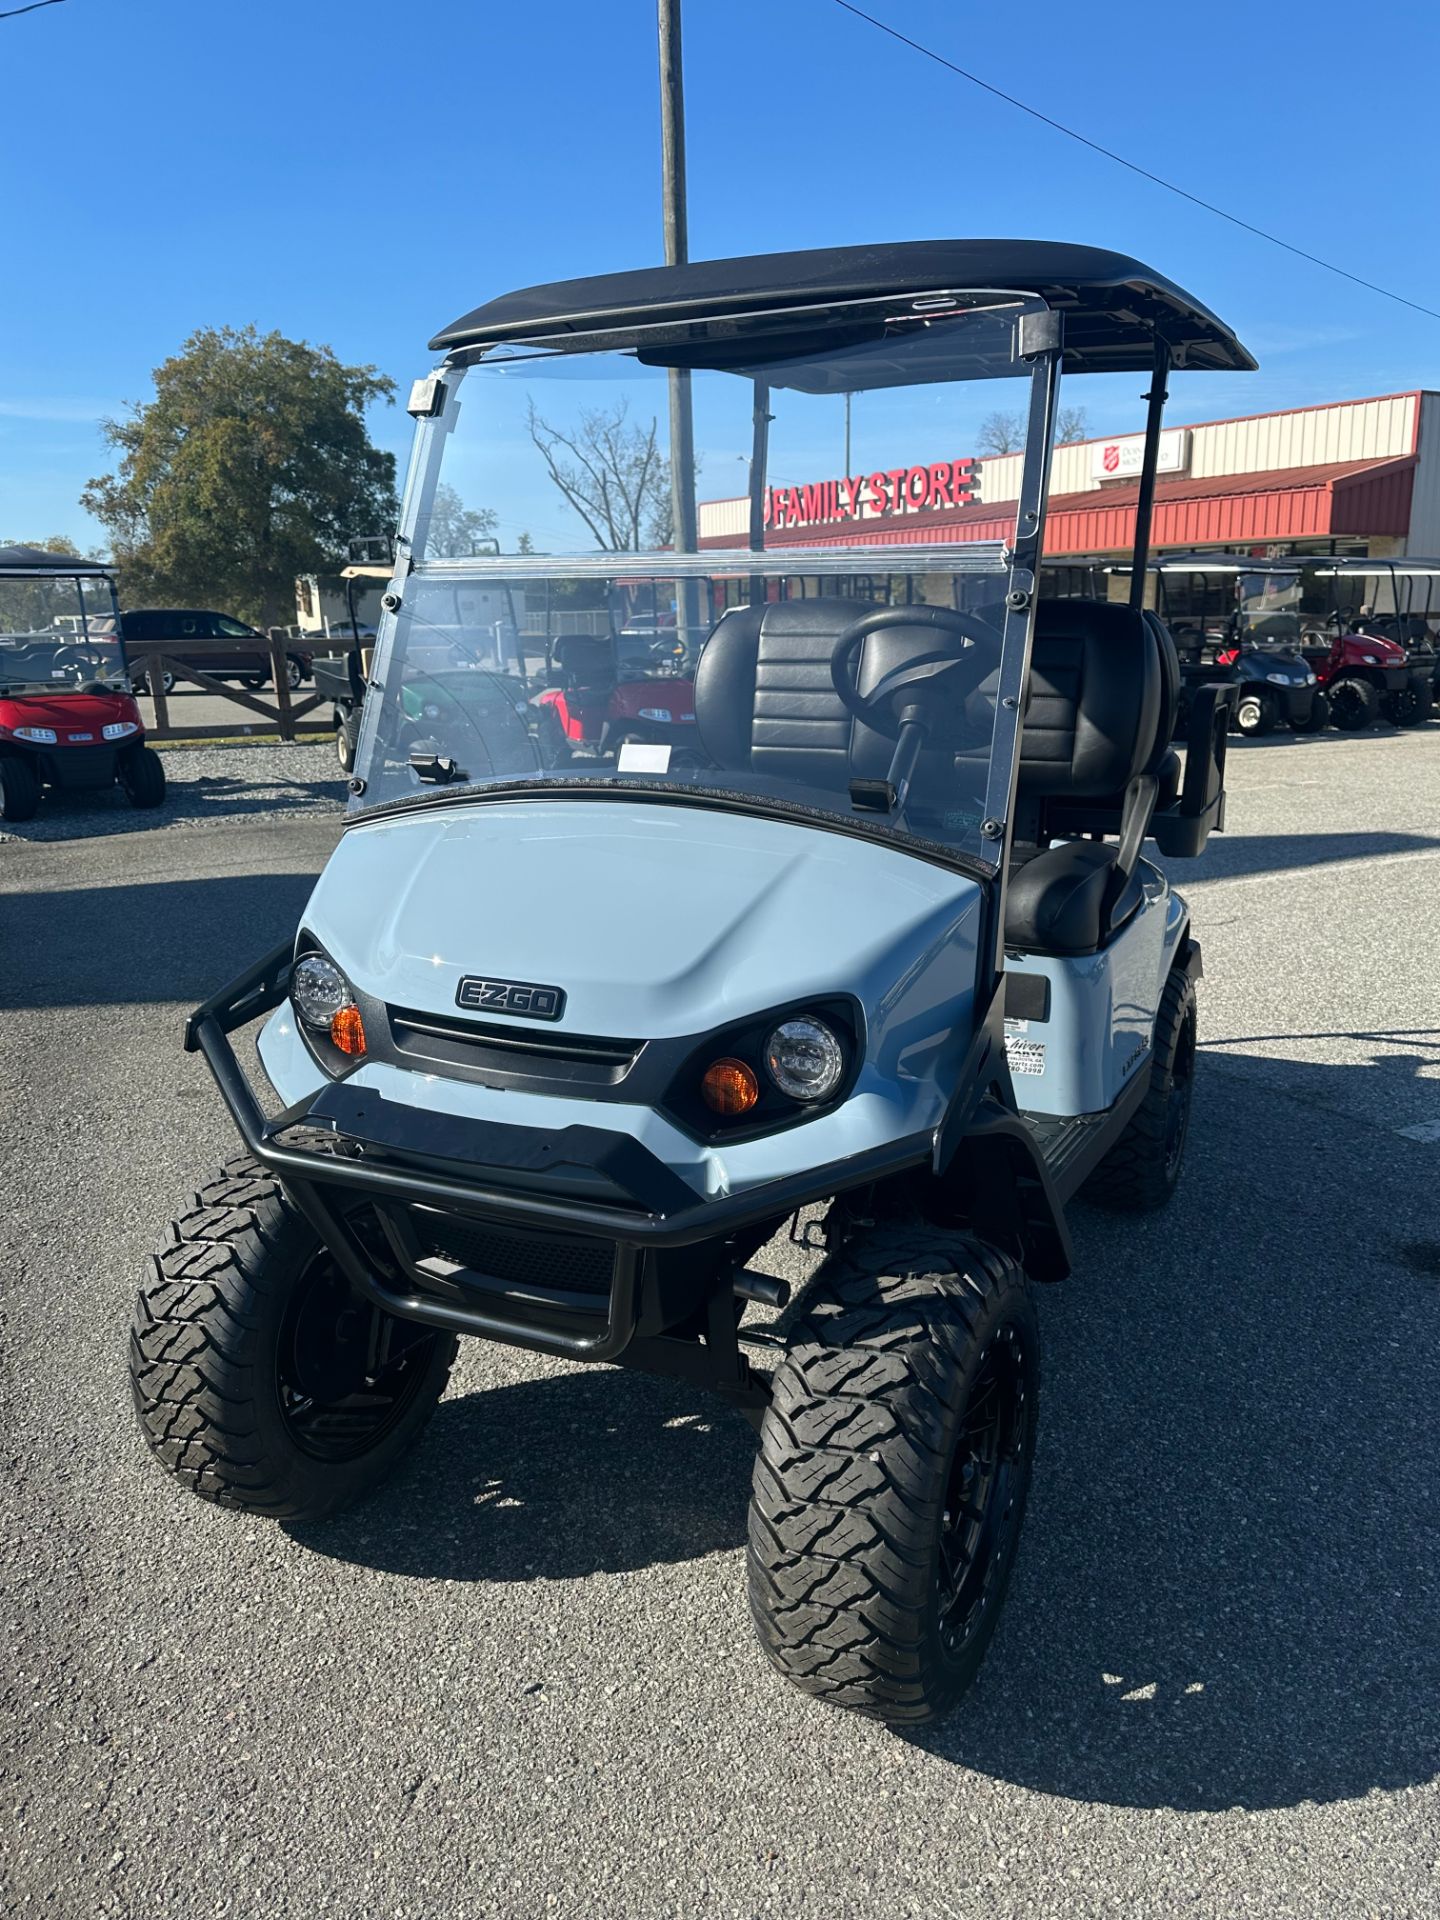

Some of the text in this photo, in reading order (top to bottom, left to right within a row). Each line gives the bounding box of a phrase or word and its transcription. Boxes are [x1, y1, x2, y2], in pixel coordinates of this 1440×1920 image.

[773, 458, 976, 526] FAMILY STORE
[460, 980, 558, 1015] EZGO
[1004, 1036, 1046, 1051] hiver
